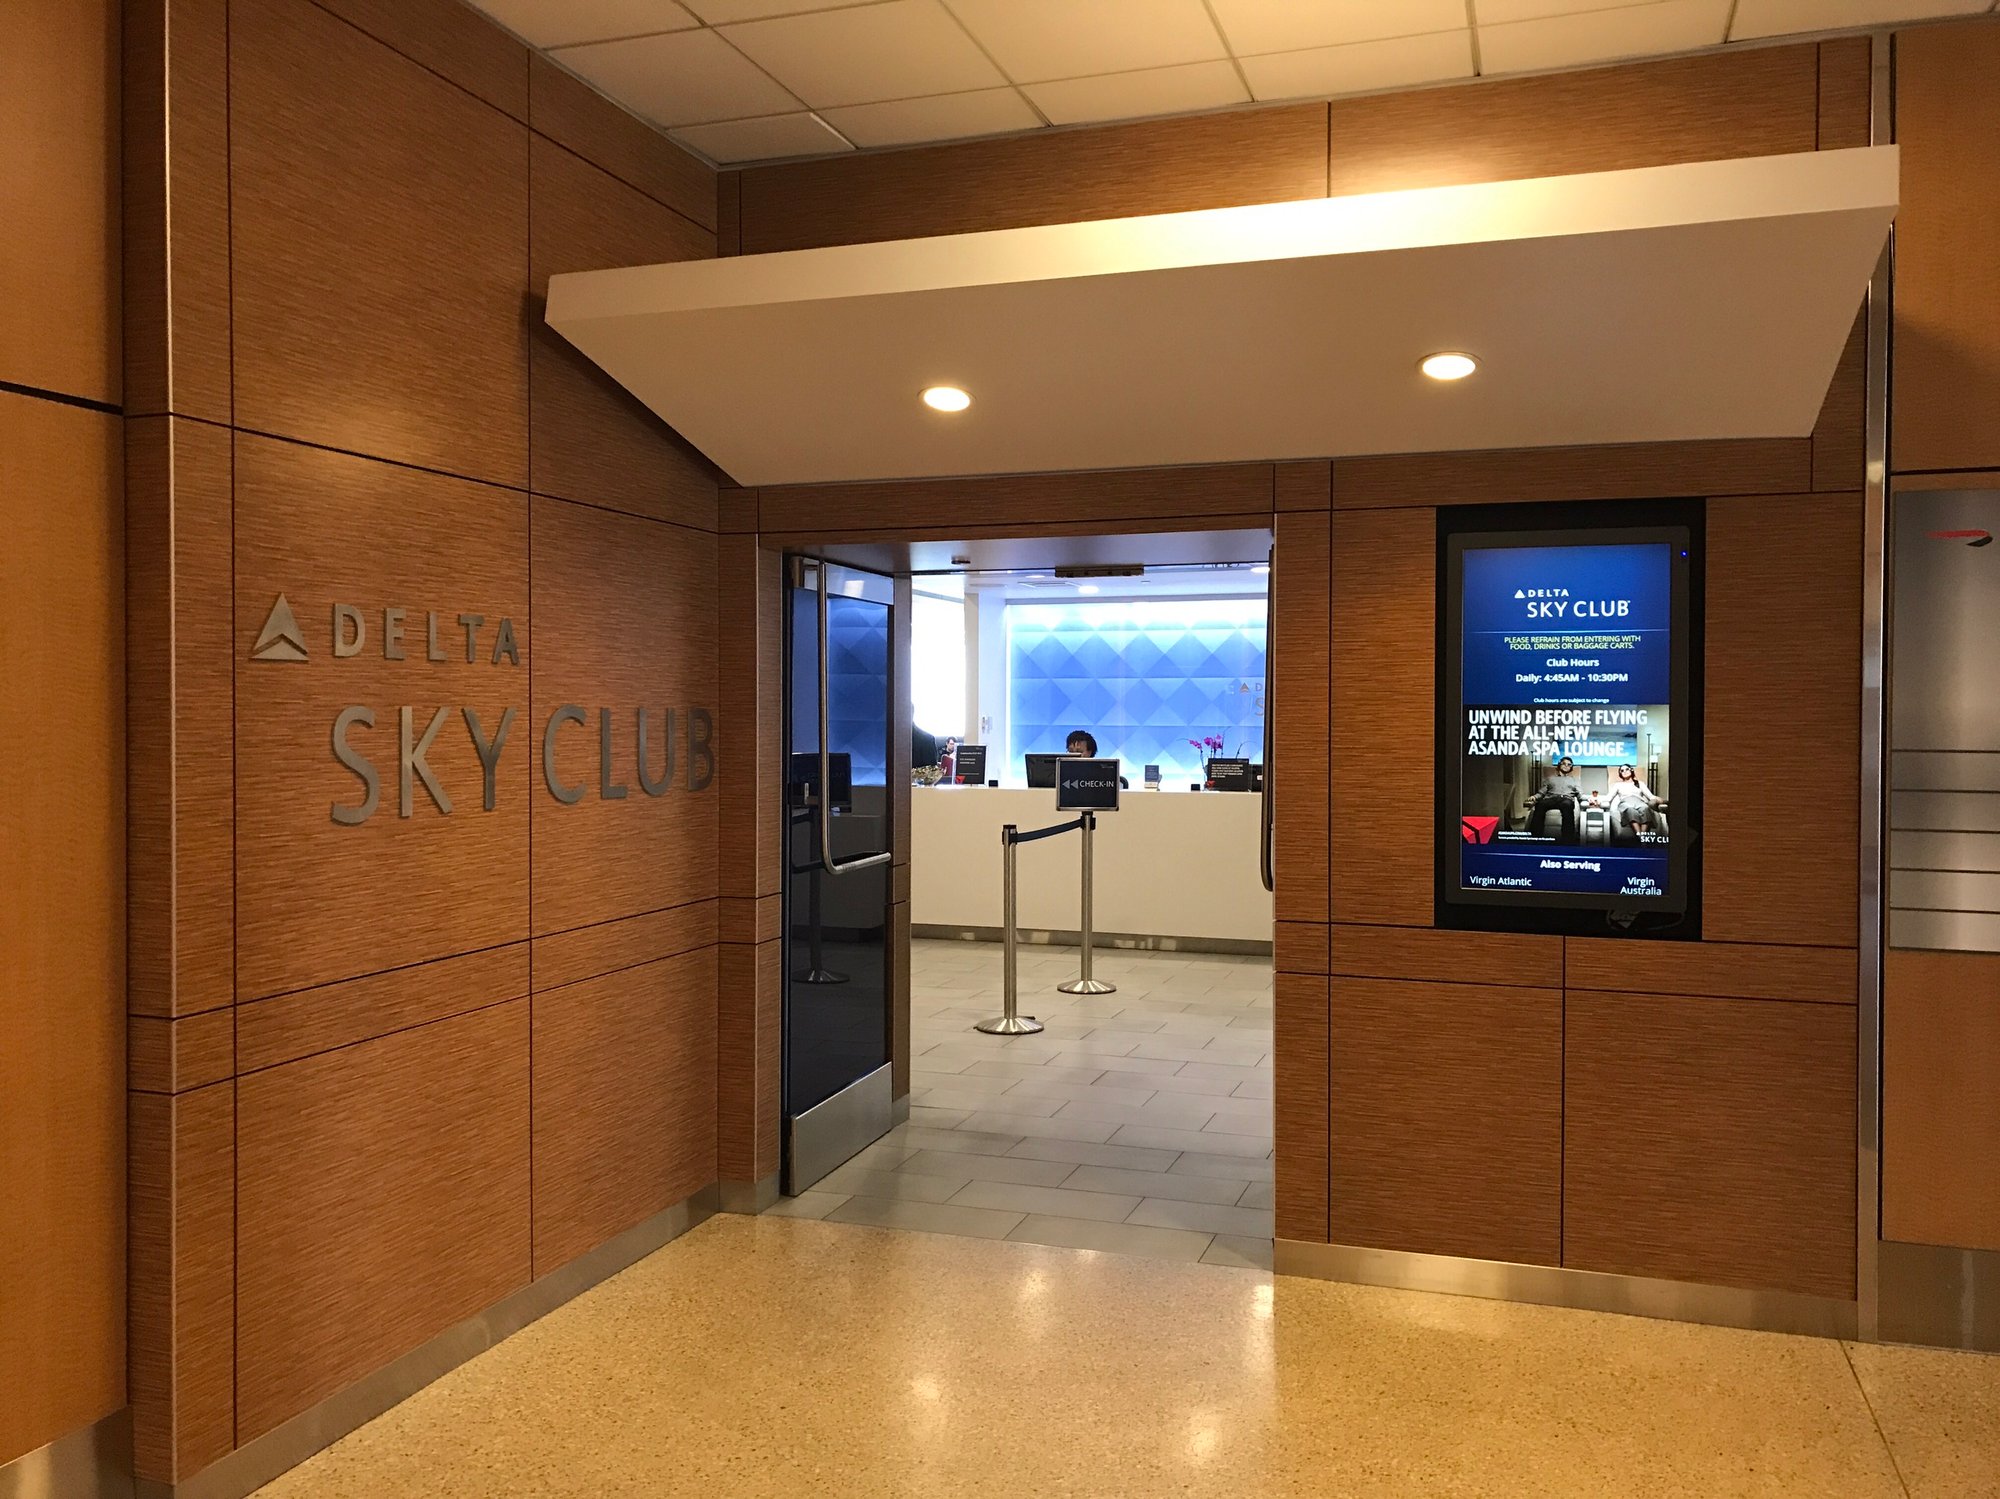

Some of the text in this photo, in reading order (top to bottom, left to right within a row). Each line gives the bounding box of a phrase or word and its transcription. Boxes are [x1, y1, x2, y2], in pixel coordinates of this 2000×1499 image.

[1527, 588, 1569, 598] DELTA
[1527, 600, 1630, 618] SKY CLUB
[333, 602, 520, 666] DELTA
[1504, 636, 1529, 644] PLEASE
[1561, 635, 1583, 643] FROM
[1584, 635, 1620, 643] ENTERING
[1574, 642, 1609, 650] BAGGAGE
[1546, 658, 1600, 667] Club Hours
[1515, 674, 1542, 684] Daily:
[1543, 674, 1580, 682] 4:45AM
[1587, 673, 1629, 682] 10:30PM
[1468, 709, 1648, 725] UNWIND BEFORE FLYING
[1468, 725, 1590, 741] AT THE ALL-NEW
[1468, 741, 1629, 757] ASANDA SPA LOUNGE.
[330, 703, 715, 826] SKY CLUB
[1079, 779, 1115, 788] CHECK-IN
[1540, 859, 1601, 872] Also Serving
[1469, 876, 1532, 887] Virgin Atlantic
[1627, 877, 1655, 887] Virgin
[1620, 886, 1662, 896] Australia
